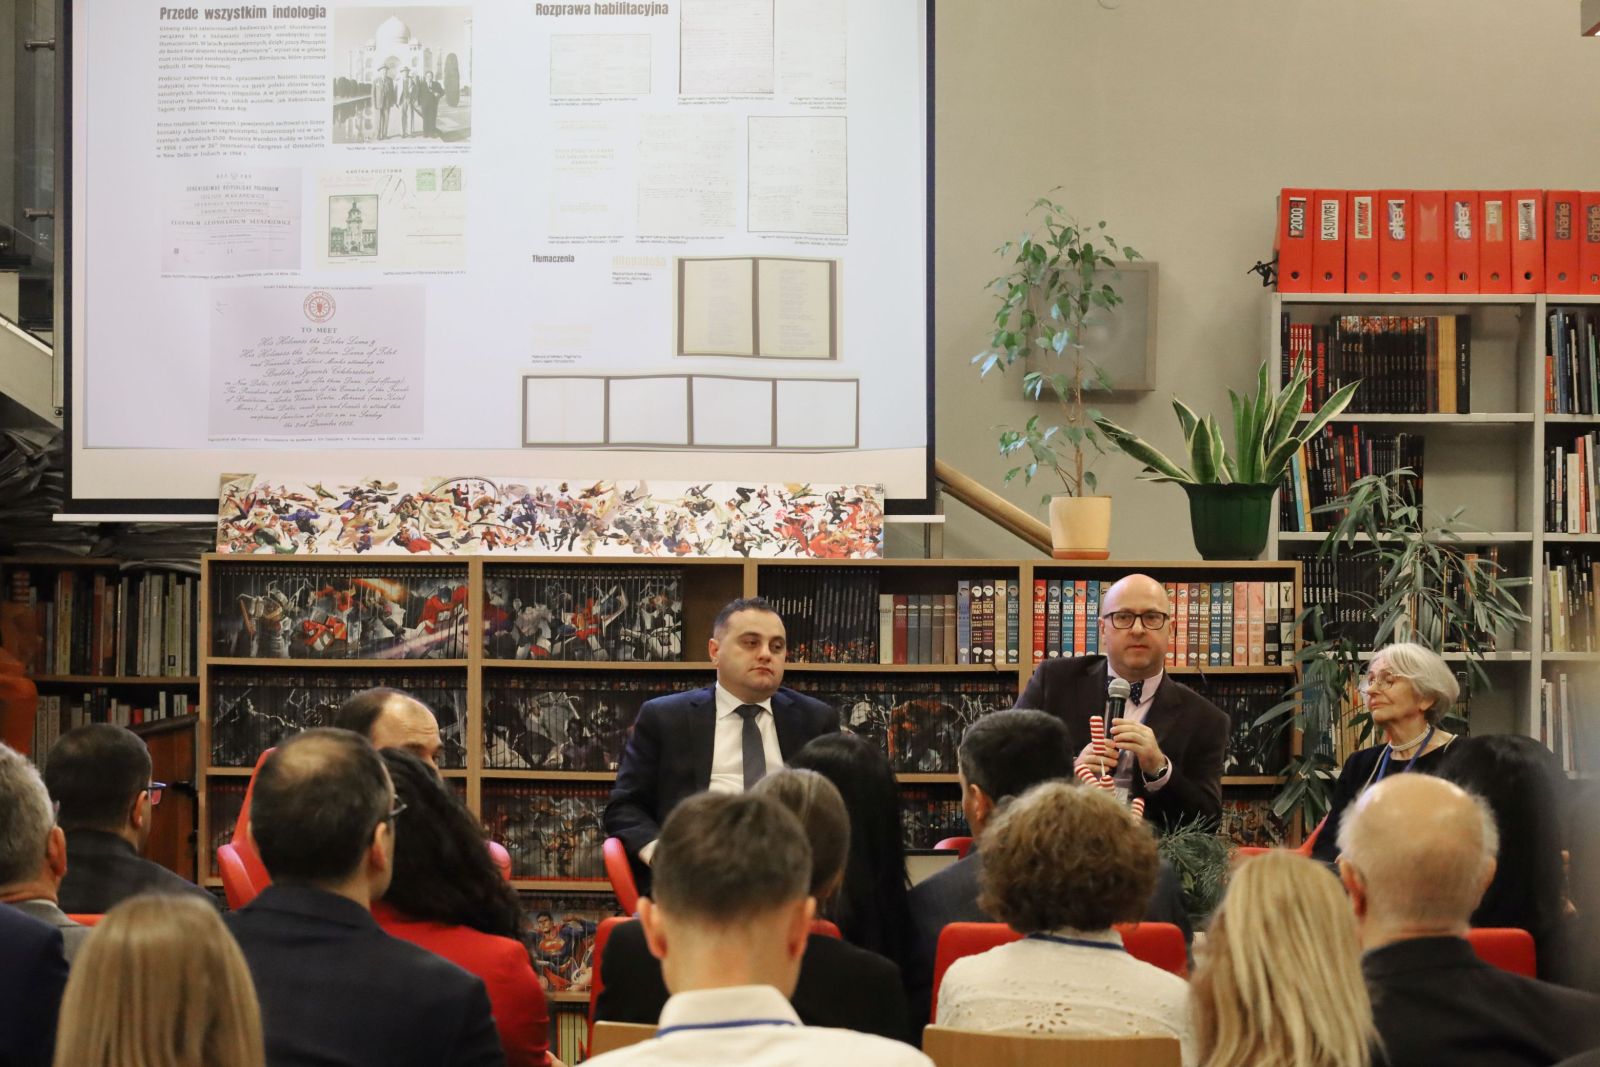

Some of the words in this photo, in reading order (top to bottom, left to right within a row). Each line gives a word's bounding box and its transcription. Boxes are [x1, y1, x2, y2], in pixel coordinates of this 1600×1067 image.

[160, 7, 199, 20] Przede
[204, 5, 267, 21] wszystkim
[272, 5, 326, 20] indologia
[535, 3, 591, 17] Rozprawa
[594, 1, 669, 17] habilitacyjna
[532, 254, 575, 263] Tłumaczenia
